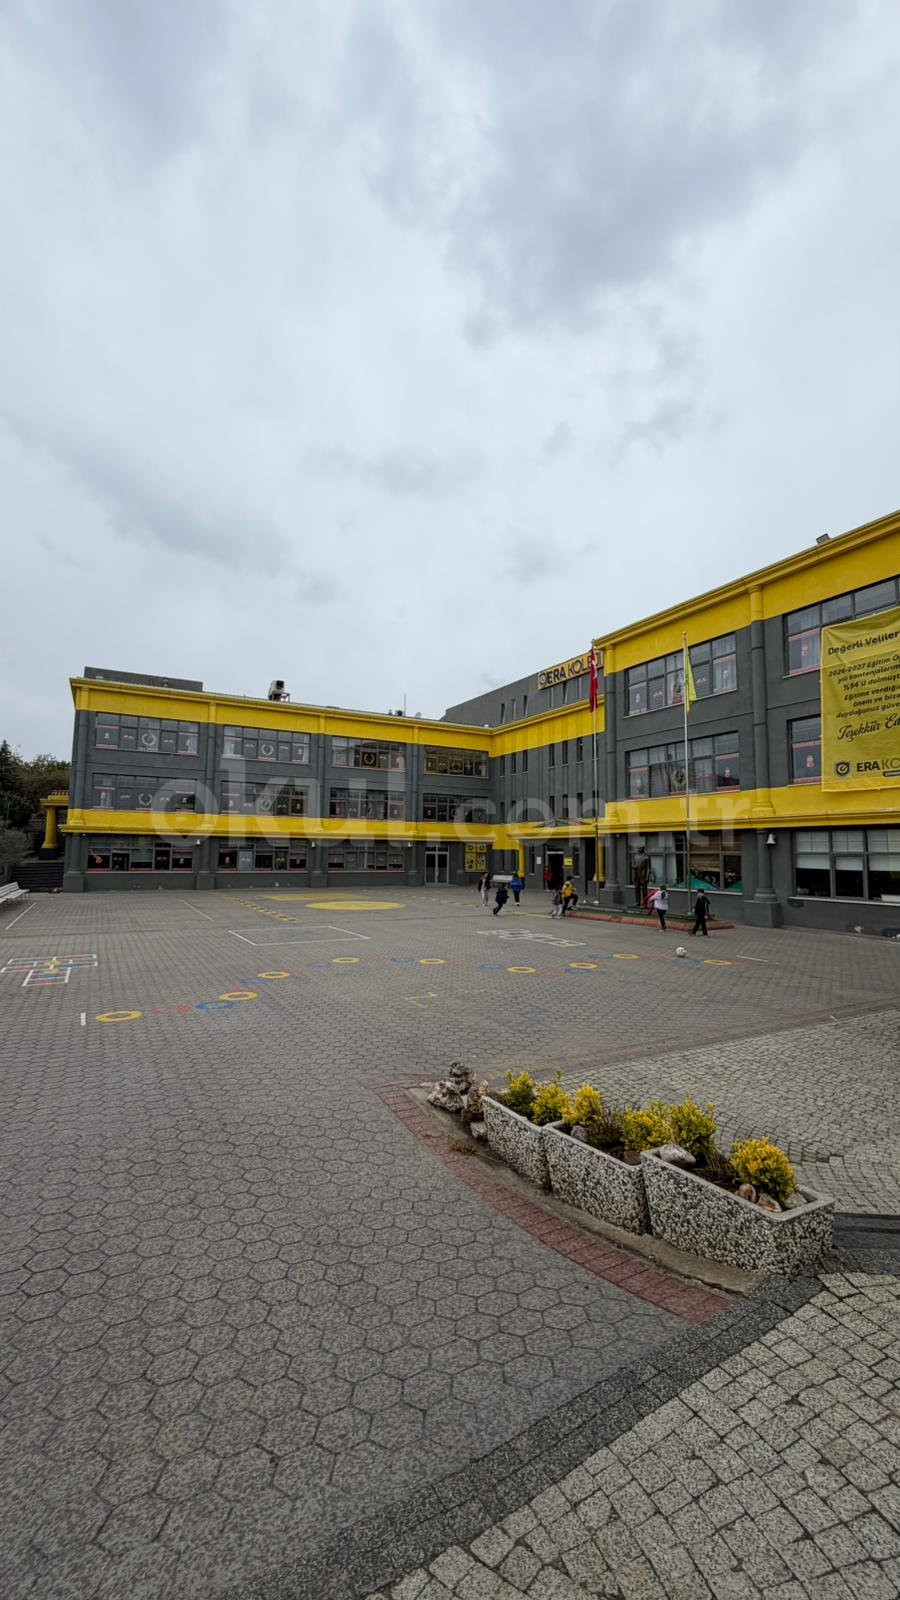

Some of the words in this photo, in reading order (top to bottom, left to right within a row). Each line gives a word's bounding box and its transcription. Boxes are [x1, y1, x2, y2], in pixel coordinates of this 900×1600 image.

[828, 640, 863, 655] Değerli
[828, 662, 866, 677] 2026-2027
[867, 657, 890, 669] Eğitim
[546, 666, 566, 684] ERA
[844, 690, 870, 701] Eğitime
[853, 698, 872, 708] önem
[836, 705, 880, 719] duyduğunuz
[837, 720, 881, 742] Teşekkür
[857, 760, 880, 772] ERA
